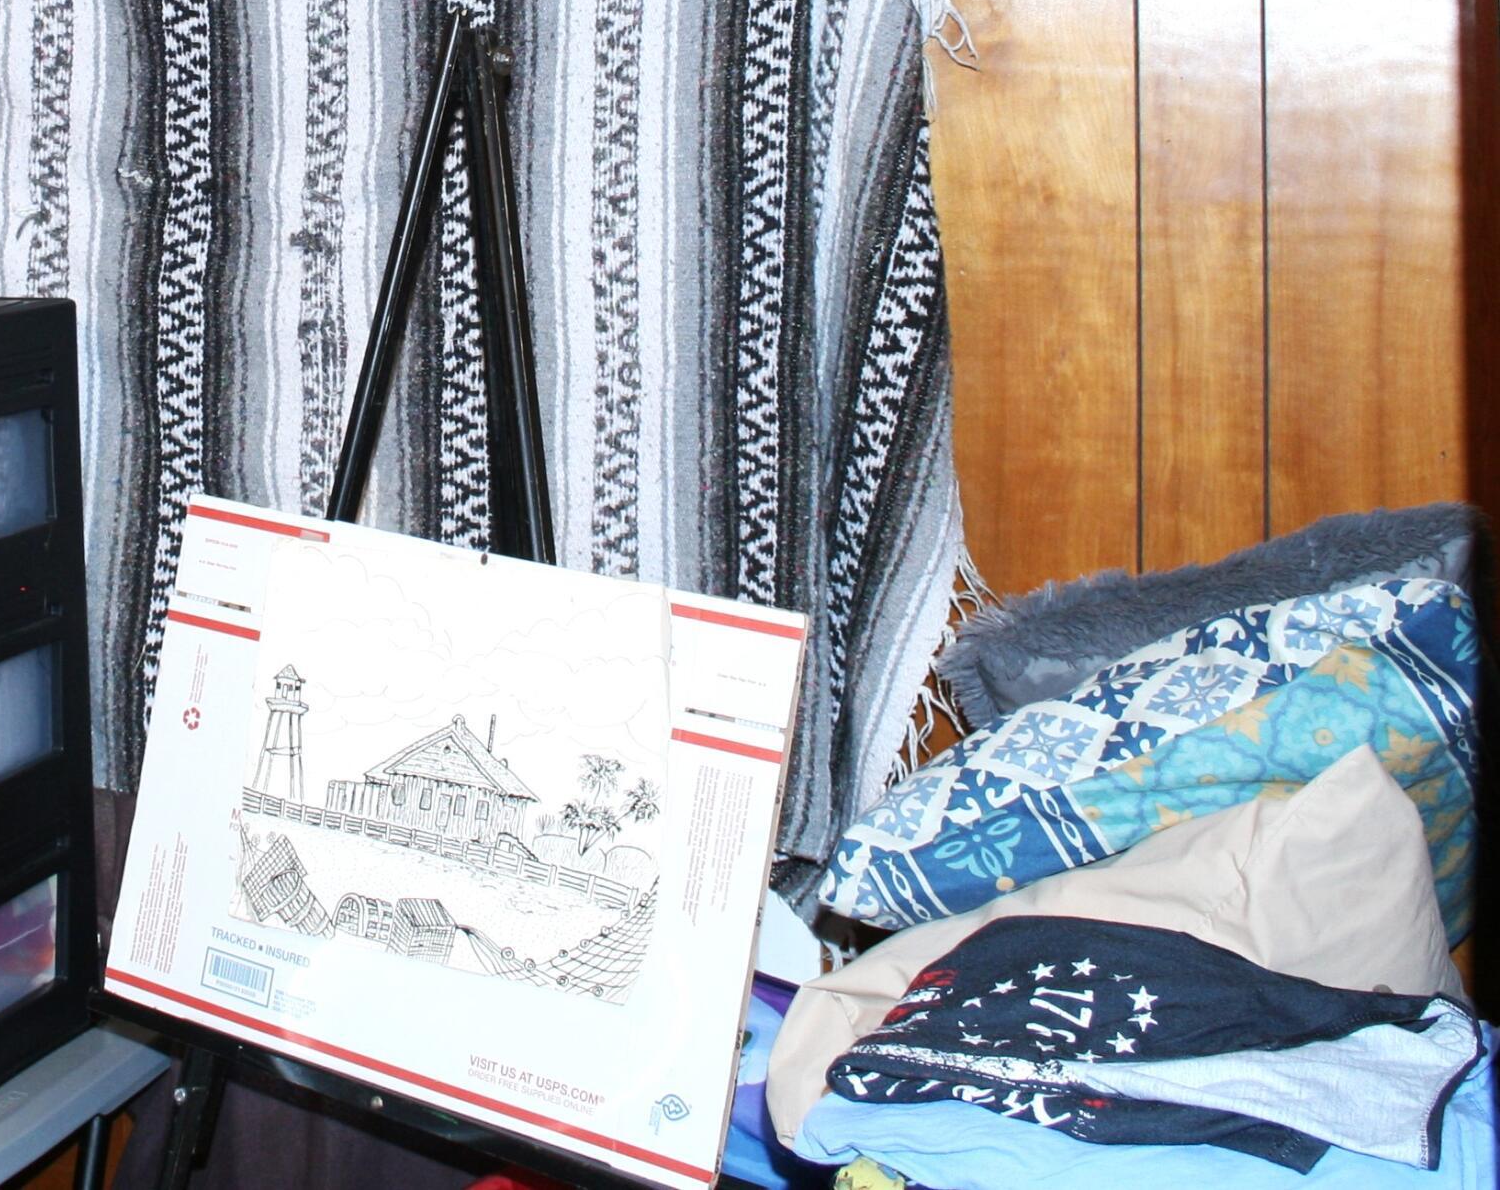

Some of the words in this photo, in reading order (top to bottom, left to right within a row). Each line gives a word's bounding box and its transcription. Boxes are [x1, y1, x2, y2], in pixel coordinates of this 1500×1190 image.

[211, 926, 257, 951] TRACKED
[265, 944, 311, 968] INSURED
[469, 1054, 498, 1073] VISIT
[500, 1064, 517, 1080] US
[518, 1071, 534, 1085] AT
[468, 1068, 497, 1086] ORDER
[498, 1077, 519, 1093] FREE
[520, 1084, 562, 1106] SUPPLIES
[563, 1099, 596, 1117] ONLINE
